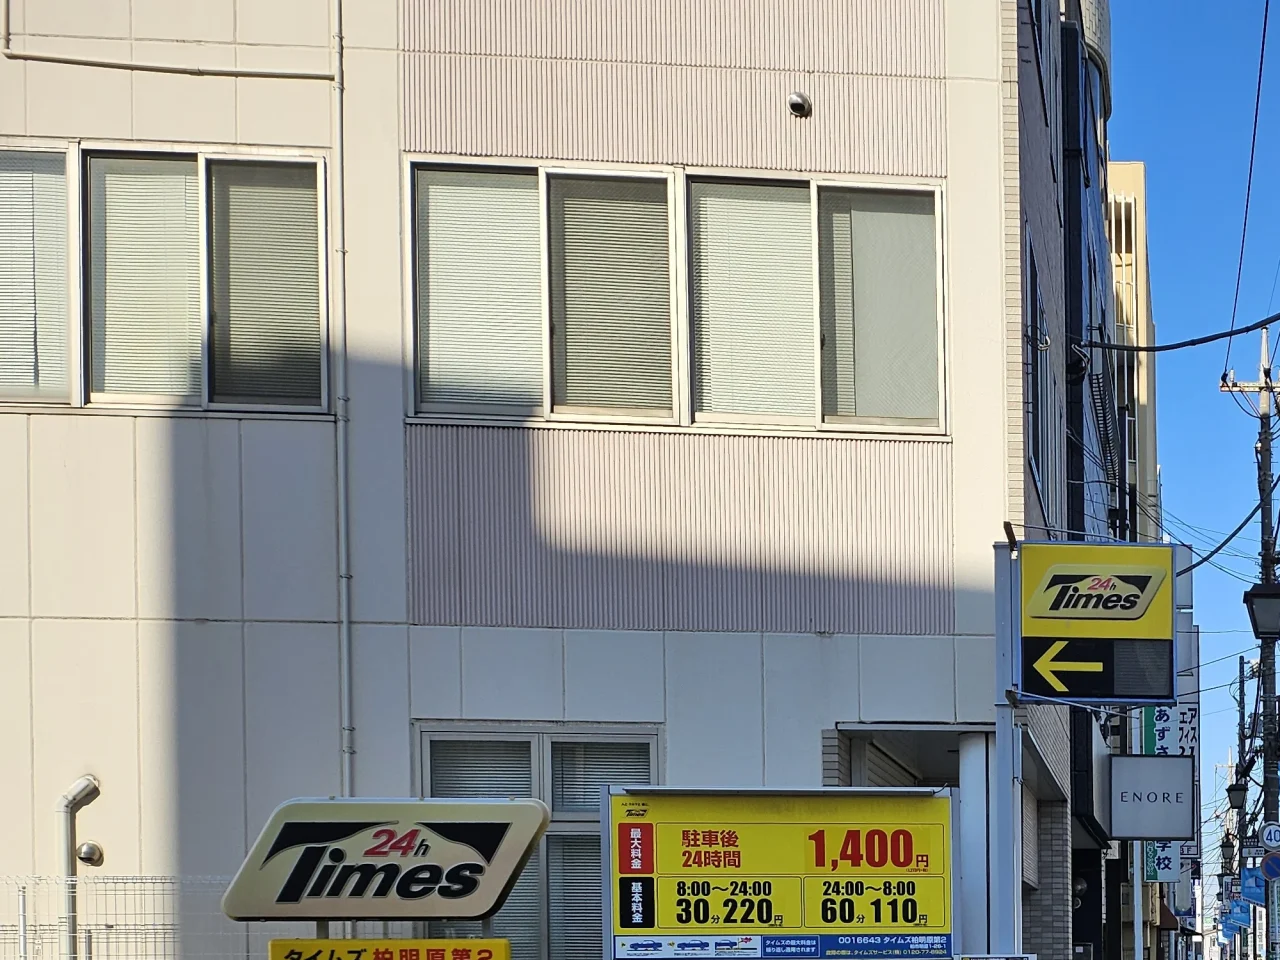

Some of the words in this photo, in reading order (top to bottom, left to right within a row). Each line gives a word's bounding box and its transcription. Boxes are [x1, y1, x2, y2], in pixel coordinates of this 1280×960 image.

[1044, 574, 1152, 611] Times
[1087, 576, 1117, 592] 24h
[1178, 726, 1198, 743] フィス
[1120, 791, 1184, 804] ENORE
[362, 827, 432, 858] 24h
[629, 827, 643, 870] 最大料金
[681, 829, 739, 848] 駐車後
[807, 828, 930, 872] 1,400円
[260, 821, 505, 905] Times
[681, 850, 742, 869] 24時間
[631, 881, 643, 924] 基本料金
[838, 936, 881, 944] 0016643
